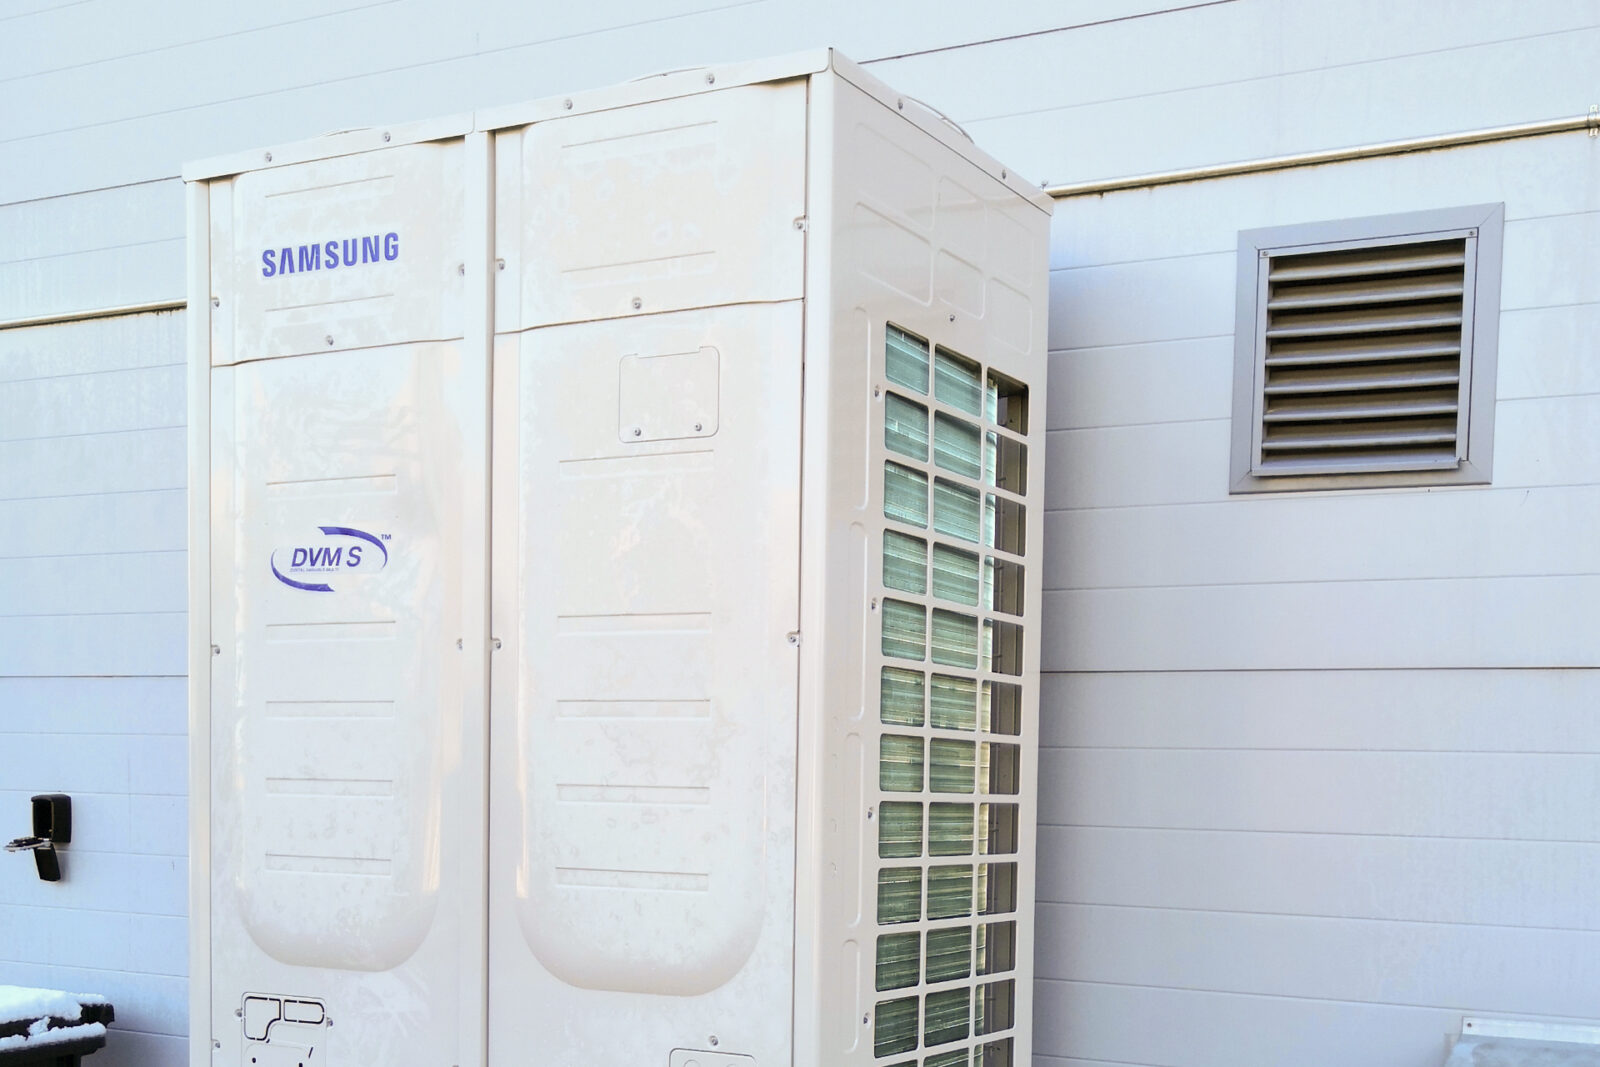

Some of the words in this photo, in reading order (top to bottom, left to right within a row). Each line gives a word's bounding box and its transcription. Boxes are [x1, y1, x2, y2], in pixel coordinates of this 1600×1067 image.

[262, 231, 399, 278] SAMSUNG
[291, 547, 343, 567] DVM
[346, 546, 363, 567] S
